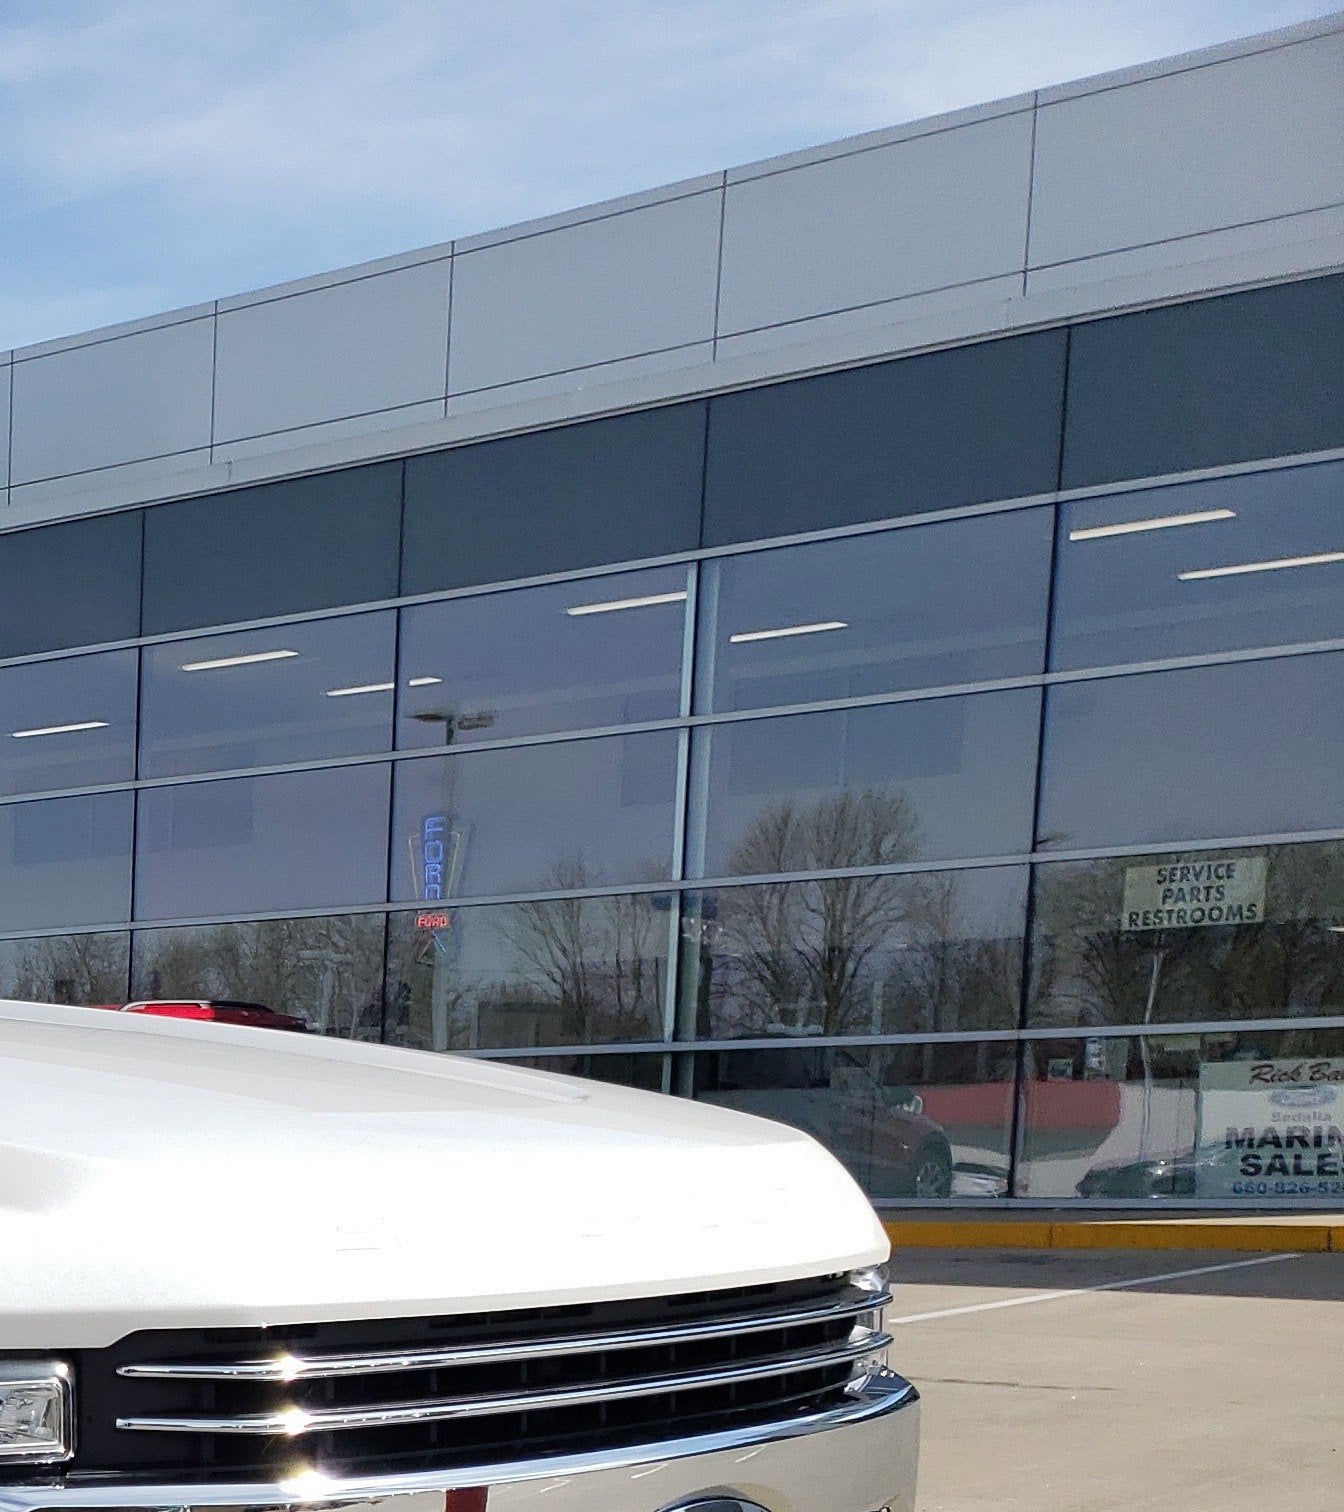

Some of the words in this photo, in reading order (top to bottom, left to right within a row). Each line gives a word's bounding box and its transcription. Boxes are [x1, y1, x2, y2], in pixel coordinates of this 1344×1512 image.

[1156, 862, 1236, 886] SERVICE
[1162, 885, 1226, 906] PARTS
[1128, 903, 1258, 928] RESTROOMS
[1249, 1063, 1305, 1085] Rick
[1240, 1151, 1344, 1176] SALE
[1233, 1181, 1344, 1195] 660-826-52
